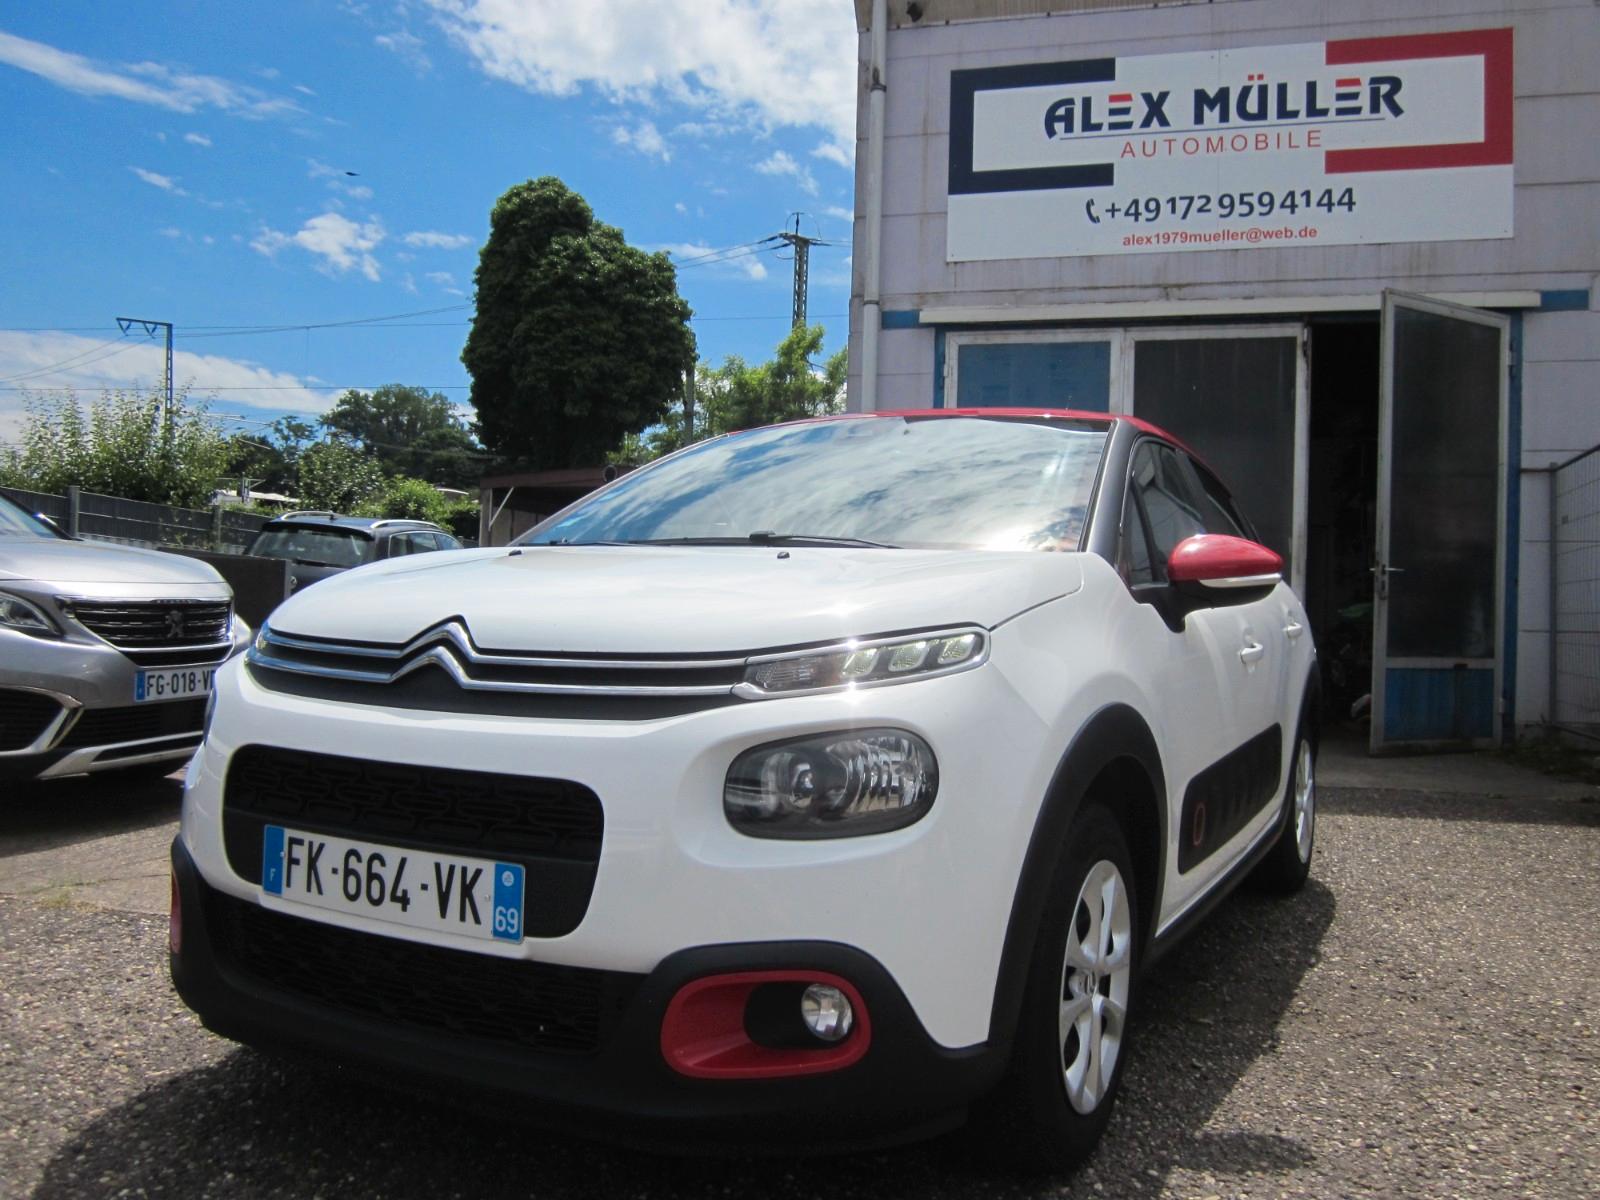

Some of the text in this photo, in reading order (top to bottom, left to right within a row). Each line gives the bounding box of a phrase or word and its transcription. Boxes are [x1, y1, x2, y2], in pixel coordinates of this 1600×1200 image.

[1044, 73, 1405, 139] ALEX MÜLLER
[1120, 130, 1321, 159] AUTOMOBILE
[1122, 226, 1318, 247] alex1979mueller@web.de
[285, 836, 484, 926] FK-664-VK
[495, 905, 519, 934] 69
